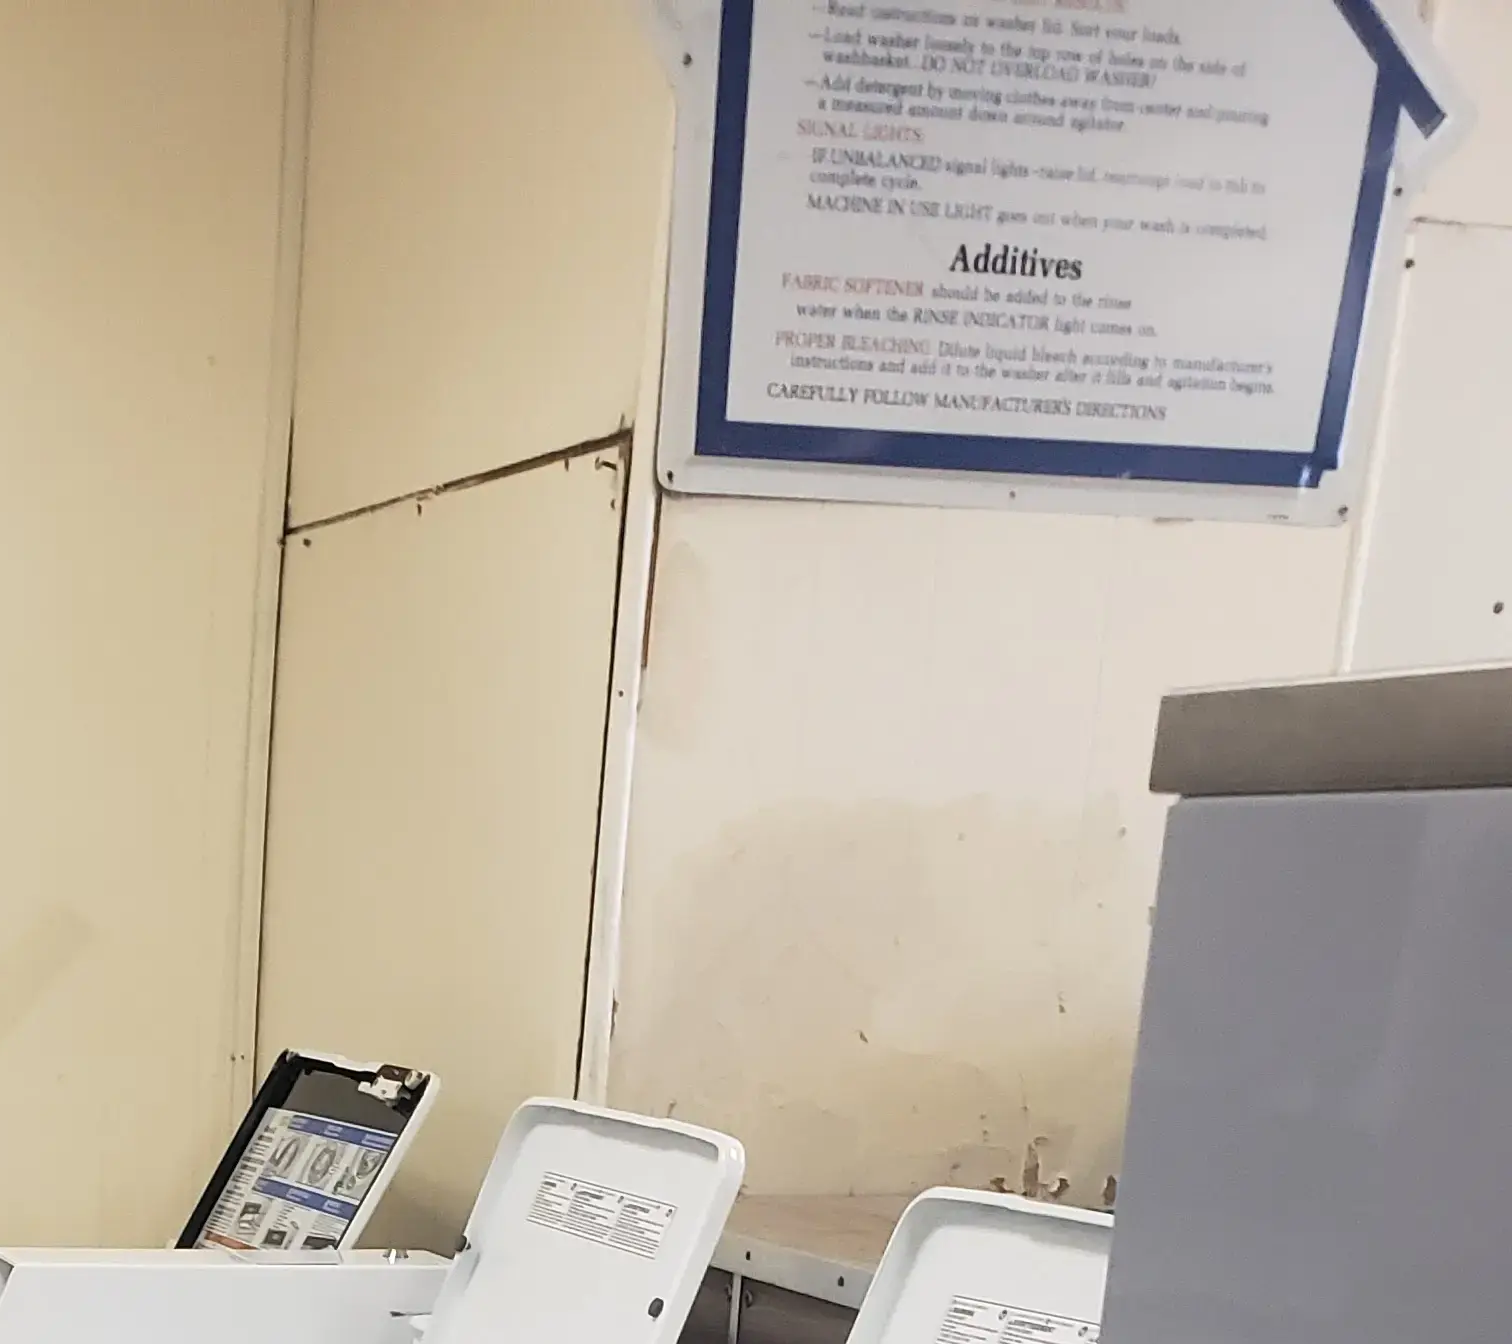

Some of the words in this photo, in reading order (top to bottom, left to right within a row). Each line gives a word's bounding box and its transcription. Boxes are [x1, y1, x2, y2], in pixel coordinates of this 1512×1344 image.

[1105, 27, 1138, 42] your
[867, 31, 919, 49] washer
[981, 41, 995, 53] to
[1000, 42, 1022, 58] the
[1089, 49, 1103, 64] of
[1173, 54, 1194, 72] the
[1200, 59, 1227, 76] side
[1231, 61, 1246, 77] of
[922, 54, 946, 72] DO
[950, 57, 985, 75] NOT
[991, 60, 1079, 82] OVERLOAD
[854, 77, 924, 97] detergent
[927, 81, 943, 99] by
[949, 85, 1002, 105] moving
[1006, 90, 1055, 107] clothes
[1060, 96, 1096, 112] away
[797, 119, 857, 138] SIGNAL
[818, 98, 827, 110] a
[832, 98, 903, 116] measured
[908, 104, 962, 118] amount
[968, 105, 1008, 122] down
[1013, 112, 1065, 128] around
[809, 169, 876, 188] complete
[812, 147, 825, 163] IF
[832, 148, 942, 172] UNBALANCED
[945, 157, 987, 175] signal
[991, 158, 1029, 179] lights
[806, 193, 881, 213] MACHINE
[888, 198, 904, 215] IN
[910, 200, 940, 217] USE
[945, 202, 993, 221] LIGHT
[996, 210, 1027, 226] goes
[1033, 211, 1055, 225] out
[1060, 211, 1098, 228] when
[1103, 217, 1134, 232] your
[1140, 216, 1174, 234] wash
[949, 243, 1082, 280] Additives
[782, 273, 839, 293] FABRIC
[845, 277, 924, 297] SOFTENER
[931, 285, 979, 301] should
[984, 287, 1000, 302] be
[1006, 287, 1047, 306] added
[1053, 292, 1066, 306] to
[1072, 292, 1092, 308] the
[796, 303, 836, 317] water
[843, 303, 881, 321] when
[886, 306, 908, 323] the
[913, 307, 958, 325] RINSE
[963, 311, 1050, 331] INDICATOR
[1054, 316, 1085, 335] light
[1090, 322, 1132, 336] comes
[774, 330, 835, 349] PROPER
[939, 340, 980, 359] Dilute
[986, 344, 1026, 363] liquid
[1031, 346, 1077, 365] bleach
[1082, 350, 1148, 370] according
[1154, 354, 1167, 368] to
[790, 351, 873, 372] instructions
[878, 357, 905, 375] and
[910, 359, 936, 376] add
[941, 361, 951, 376] it
[956, 363, 969, 377] to
[975, 363, 996, 379] the
[1001, 366, 1049, 382] washer
[1054, 368, 1086, 384] after
[1092, 370, 1101, 384] it
[1136, 373, 1163, 389] and
[1167, 376, 1227, 392] agitation
[767, 382, 858, 403] CAREFULLY
[863, 388, 929, 407] FOLLOW
[1076, 401, 1167, 420] DIRECTIONS
